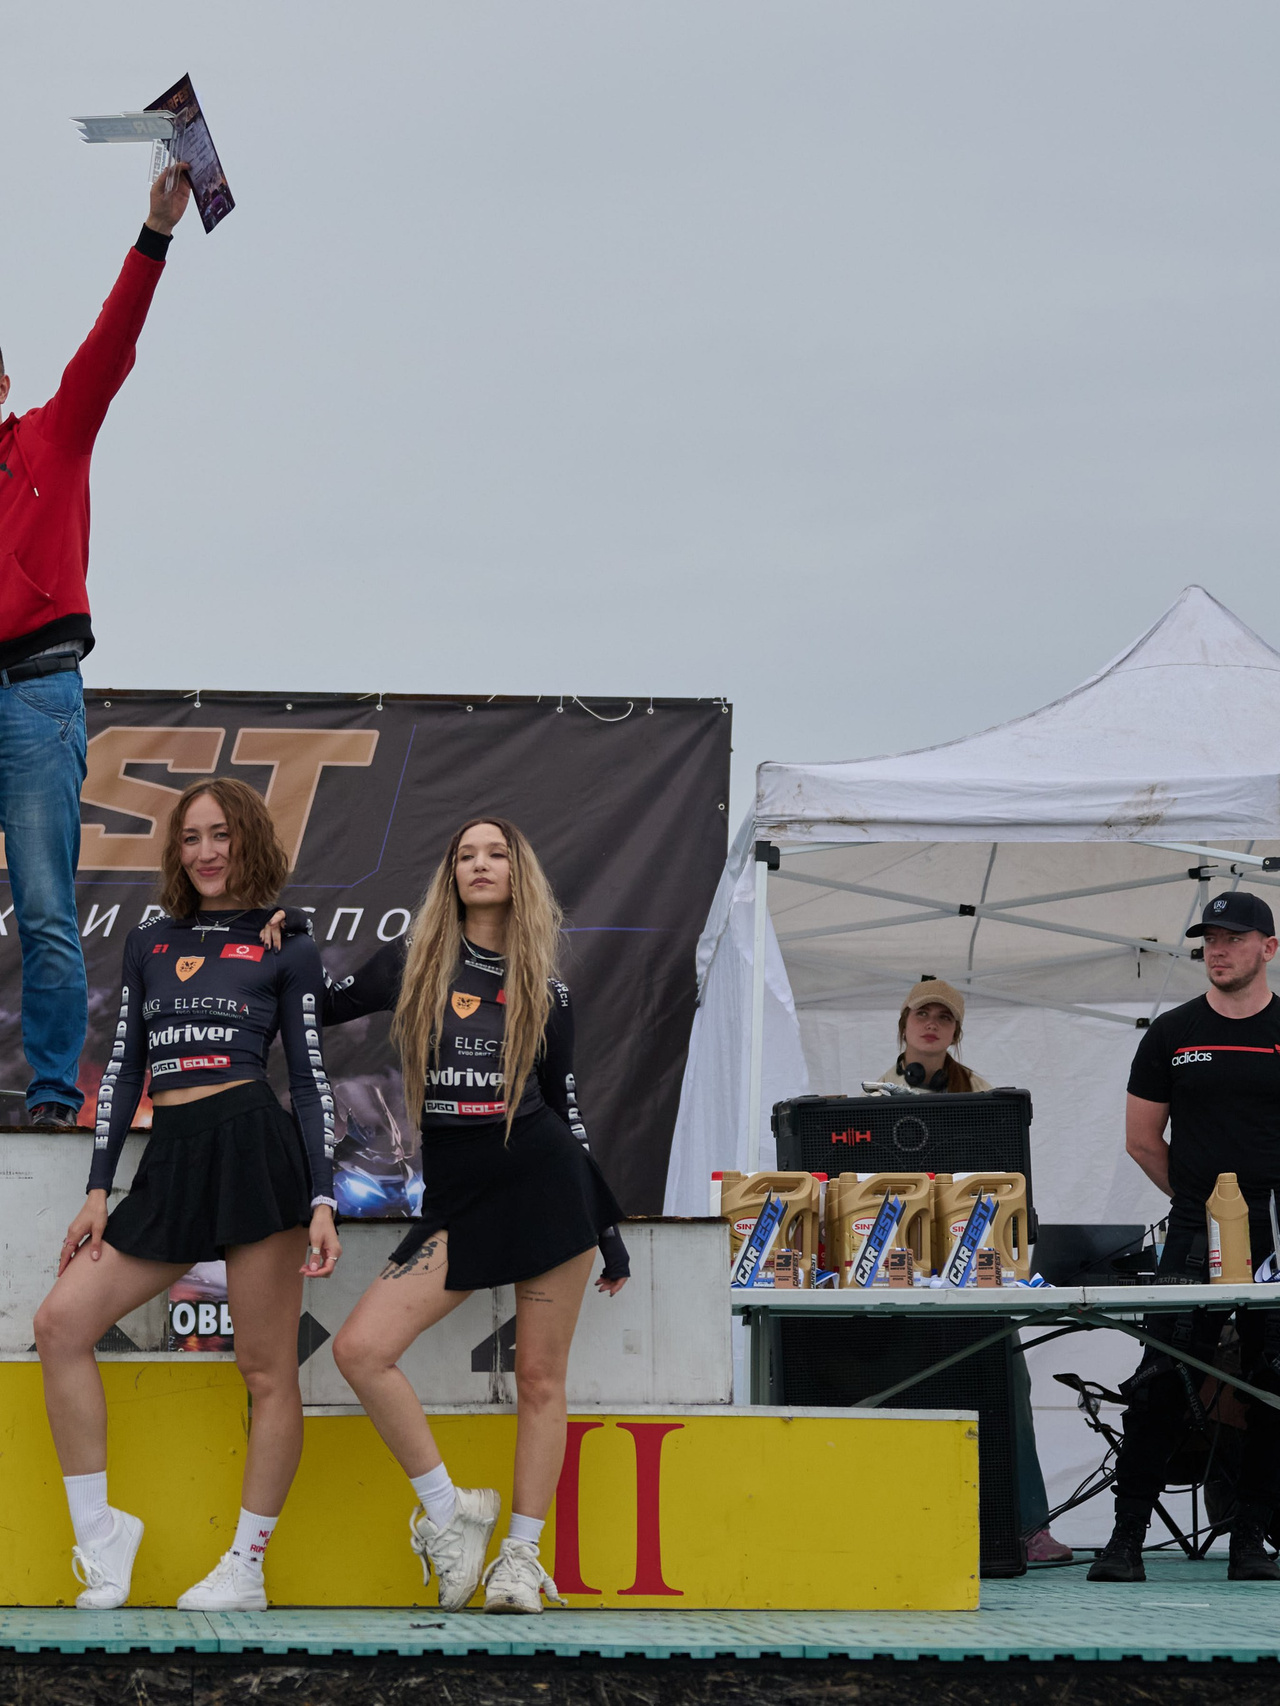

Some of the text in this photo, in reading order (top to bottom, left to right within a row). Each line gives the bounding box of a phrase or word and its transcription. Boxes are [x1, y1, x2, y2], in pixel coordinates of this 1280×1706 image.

[174, 997, 249, 1015] ELECTRA
[455, 1036, 507, 1052] ELEC
[183, 1058, 227, 1069] GOLD
[1172, 1050, 1212, 1066] adidas
[425, 1067, 507, 1087] Evdrive
[736, 1202, 780, 1285] CARFEST
[856, 1202, 898, 1285] CARFEST
[949, 1200, 991, 1285] CARFEST
[776, 1255, 791, 1268] 3
[891, 1254, 906, 1267] 3
[979, 1254, 994, 1267] 3
